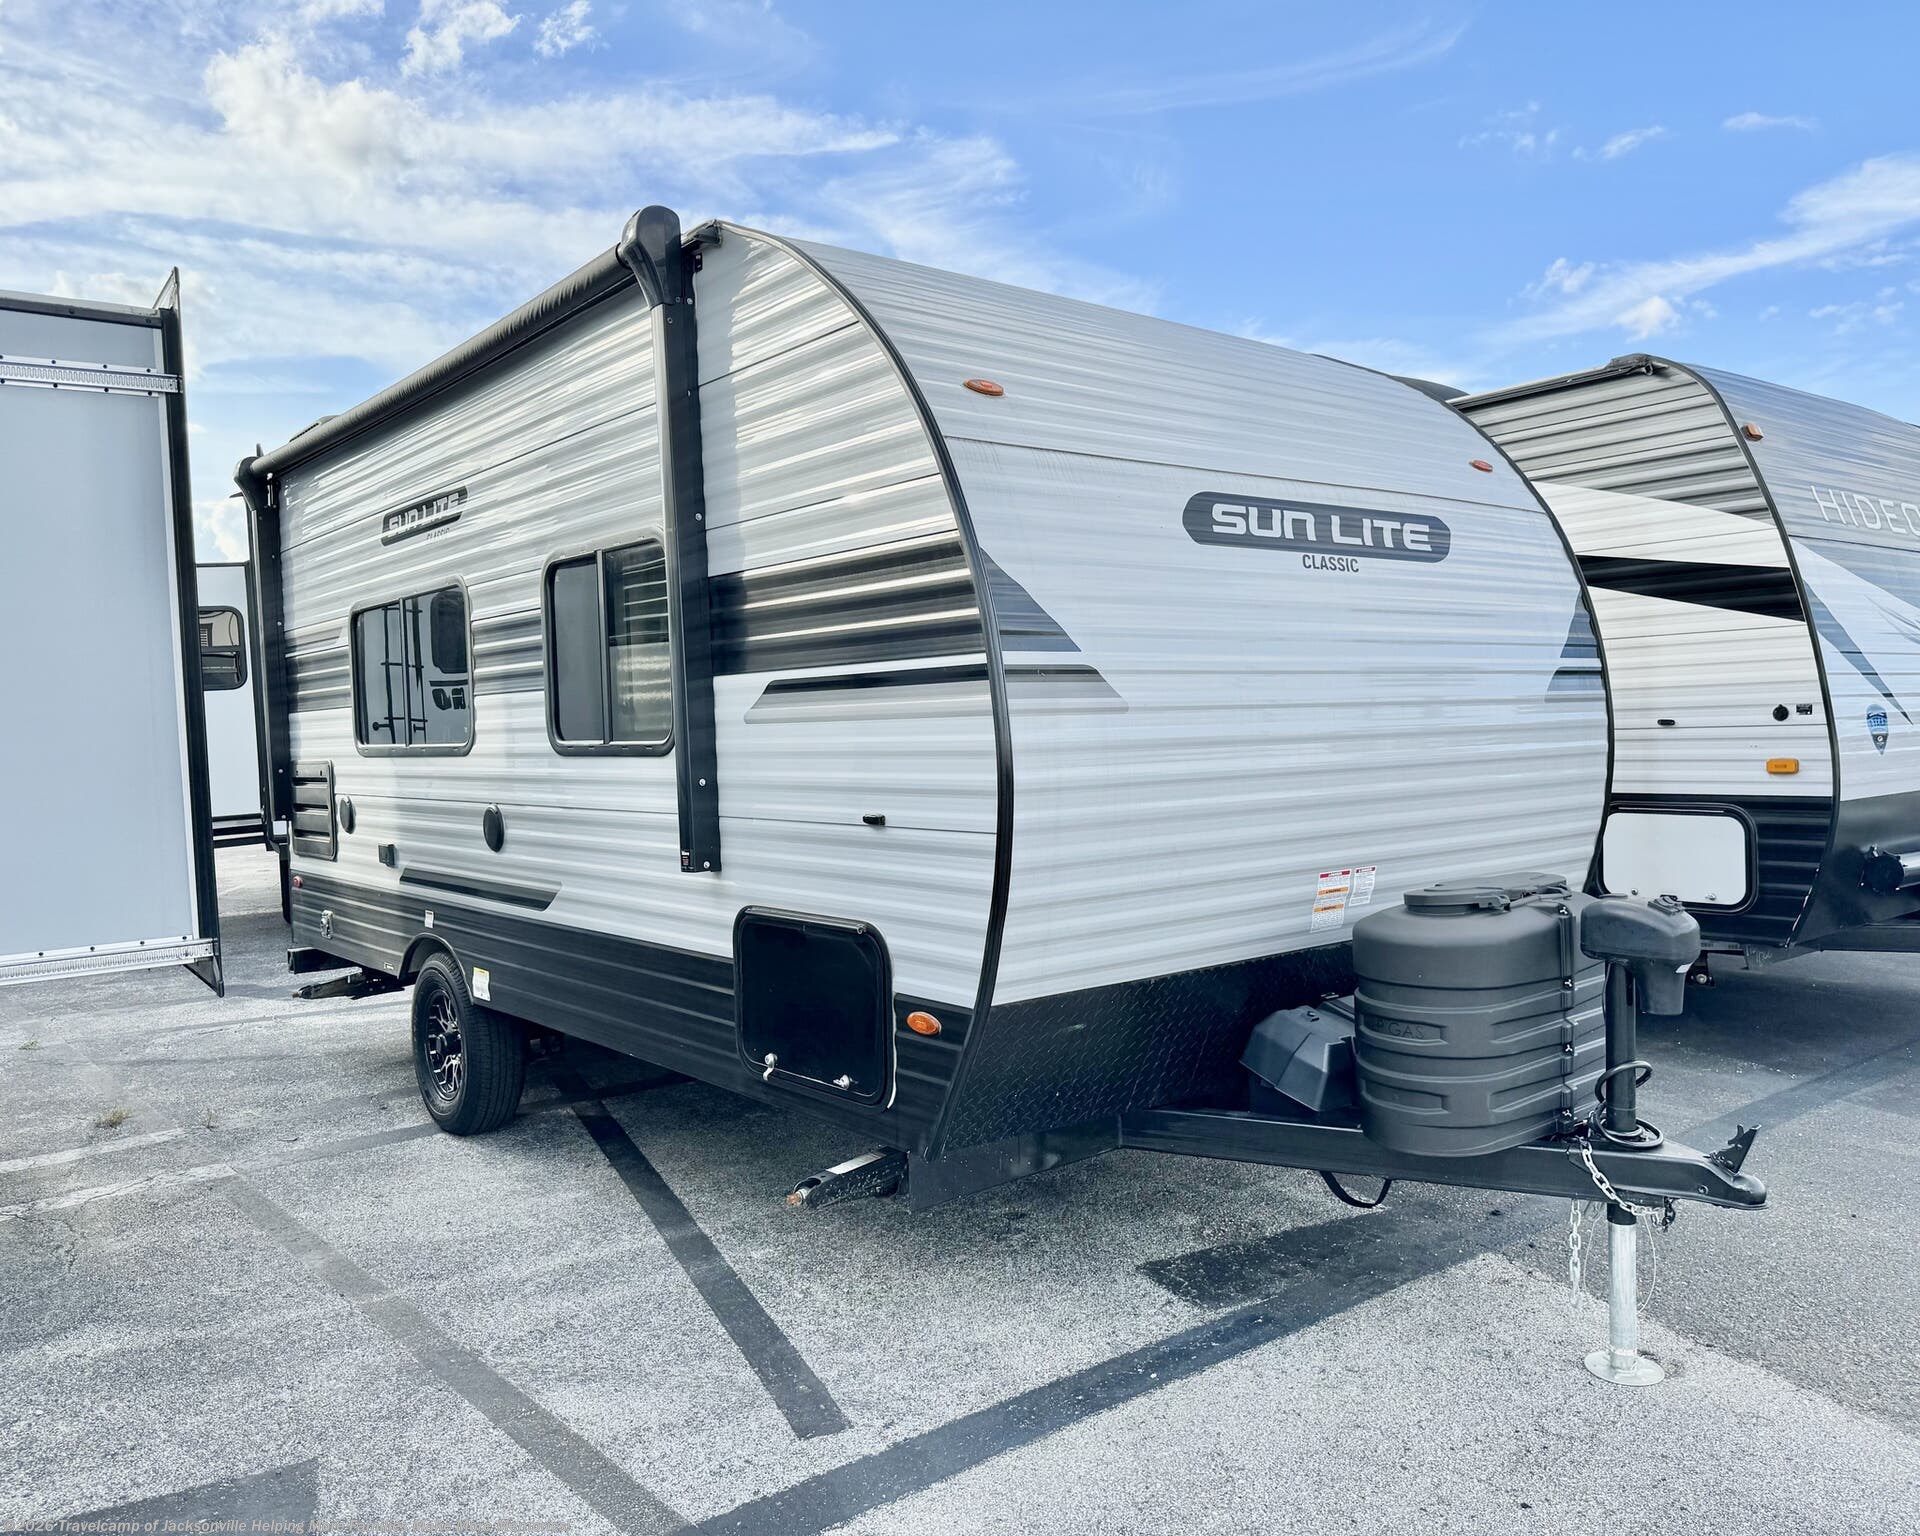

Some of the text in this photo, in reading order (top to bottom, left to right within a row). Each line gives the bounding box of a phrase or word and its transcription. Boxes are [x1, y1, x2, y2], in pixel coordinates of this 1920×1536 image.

[421, 492, 460, 527] LITE
[1211, 503, 1432, 551] SUN LITE
[1302, 554, 1359, 572] CLASSIC
[1388, 1022, 1425, 1039] GAS
